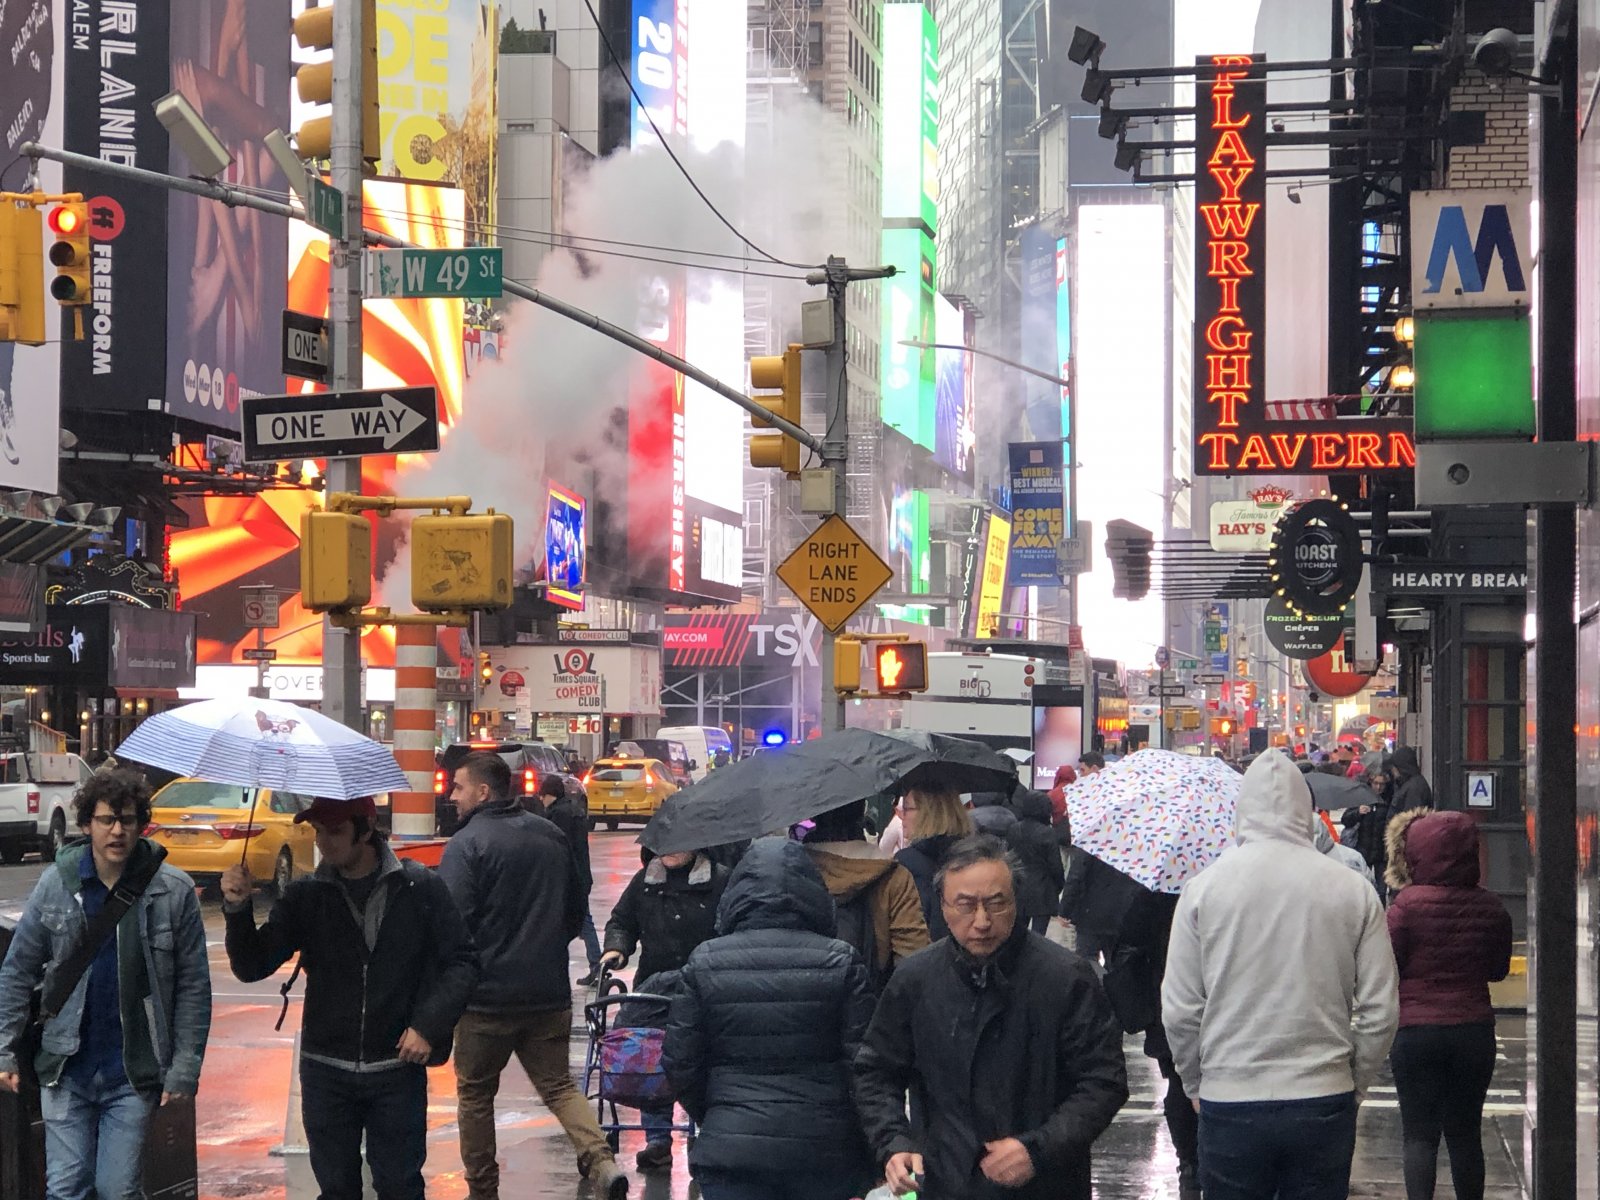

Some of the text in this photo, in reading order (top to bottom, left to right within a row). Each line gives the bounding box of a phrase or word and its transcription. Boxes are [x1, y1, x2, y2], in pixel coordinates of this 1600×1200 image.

[1200, 55, 1260, 426] PLAYWRIGHT
[405, 255, 495, 291] W 49 St
[93, 243, 112, 375] FREEFORM
[294, 332, 318, 361] ONE
[271, 410, 406, 441] ONE WAY
[1200, 433, 1415, 470] TAVERN
[1021, 467, 1053, 477] WINNER!
[1013, 477, 1062, 488] BEST MUSICAL
[672, 413, 685, 592] HERSHEY'
[1257, 494, 1283, 502] RAY'S
[1013, 508, 1062, 521] COME
[1230, 509, 1268, 521] Famous
[1218, 523, 1266, 535] RAY'S
[808, 543, 860, 559] RIGHT
[809, 565, 858, 581] LANE
[1392, 573, 1465, 587] HEARTY
[810, 587, 857, 603] ENDS
[748, 614, 819, 667] TSX
[3, 653, 50, 665] Sports bar
[553, 673, 600, 684] TIMES SQUARE
[960, 679, 978, 688] BIG
[556, 685, 599, 699] COMEDY
[579, 697, 600, 707] CLUB
[1472, 779, 1489, 797] A
